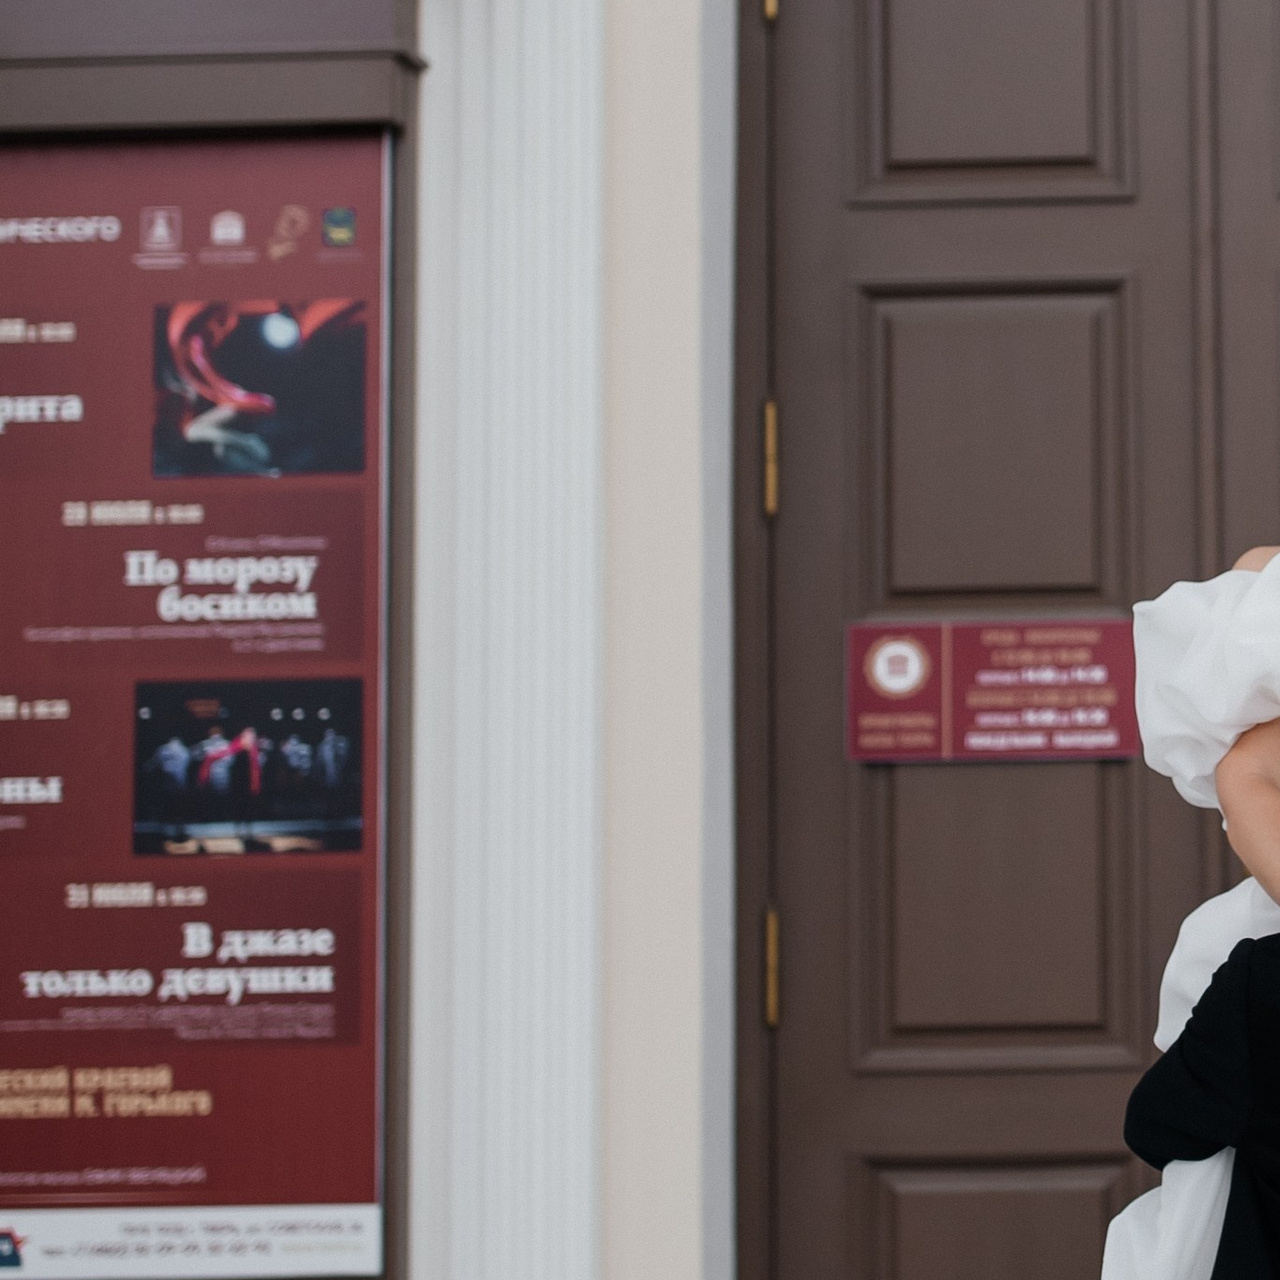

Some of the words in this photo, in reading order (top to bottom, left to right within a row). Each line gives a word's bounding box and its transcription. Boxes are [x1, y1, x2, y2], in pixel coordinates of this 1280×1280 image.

[125, 550, 178, 585] По
[184, 556, 317, 592] морозу
[182, 922, 213, 958] В
